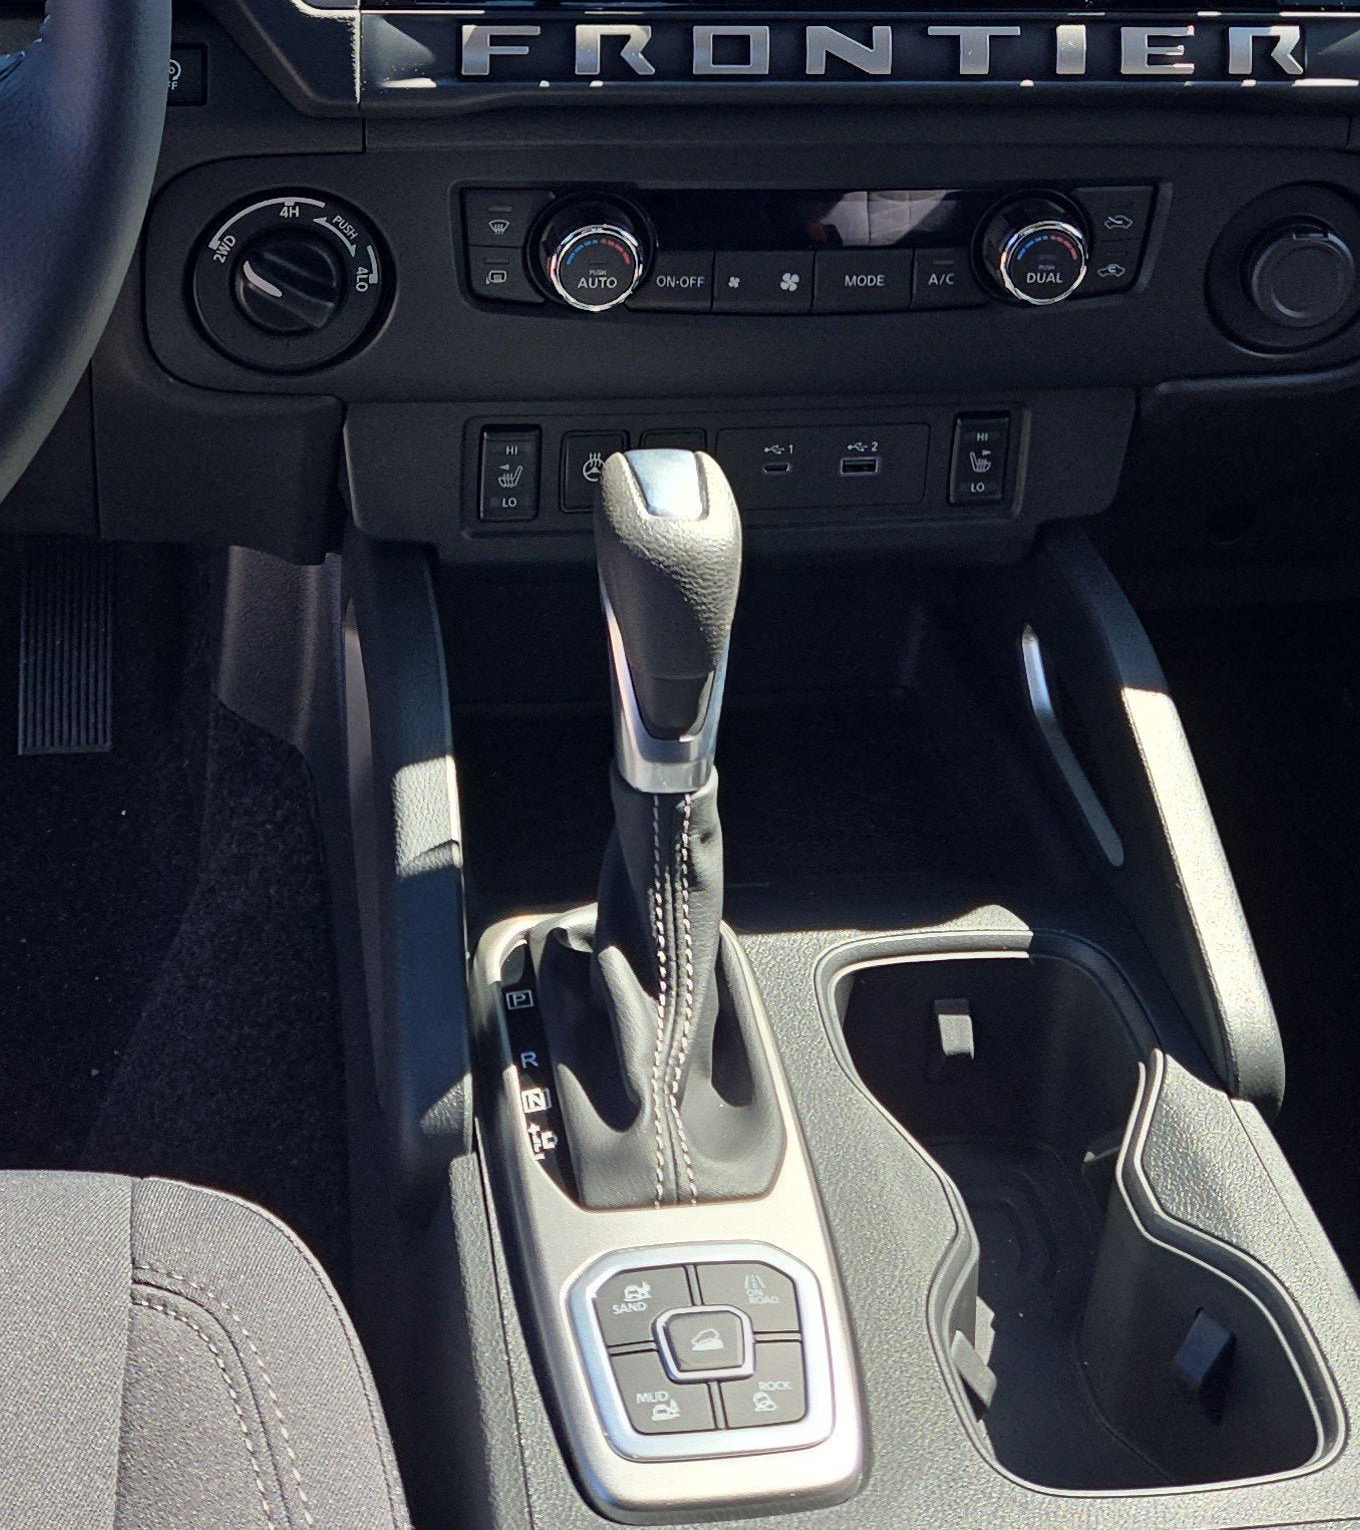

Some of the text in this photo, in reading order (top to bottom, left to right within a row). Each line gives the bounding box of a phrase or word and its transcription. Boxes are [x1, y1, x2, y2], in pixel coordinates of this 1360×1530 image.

[461, 25, 1304, 75] FRONTIER
[279, 205, 300, 218] 4H
[332, 214, 359, 240] PUSH
[213, 234, 237, 264] 2WD
[355, 266, 369, 292] 4LO
[578, 277, 618, 289] AUTO
[844, 274, 885, 286] MODE
[928, 273, 955, 286] A/C
[1026, 272, 1063, 284] DUAL
[976, 432, 989, 442] HI
[506, 445, 518, 455] HI
[788, 444, 794, 454] 1
[871, 441, 879, 452] 2
[971, 482, 985, 492] LO
[502, 497, 517, 508] LO
[513, 993, 527, 1006] P
[520, 1051, 539, 1069] R
[749, 1296, 780, 1304] ROAD
[612, 1302, 648, 1315] SAND
[758, 1381, 793, 1390] ROCK
[636, 1391, 670, 1404] MUD
